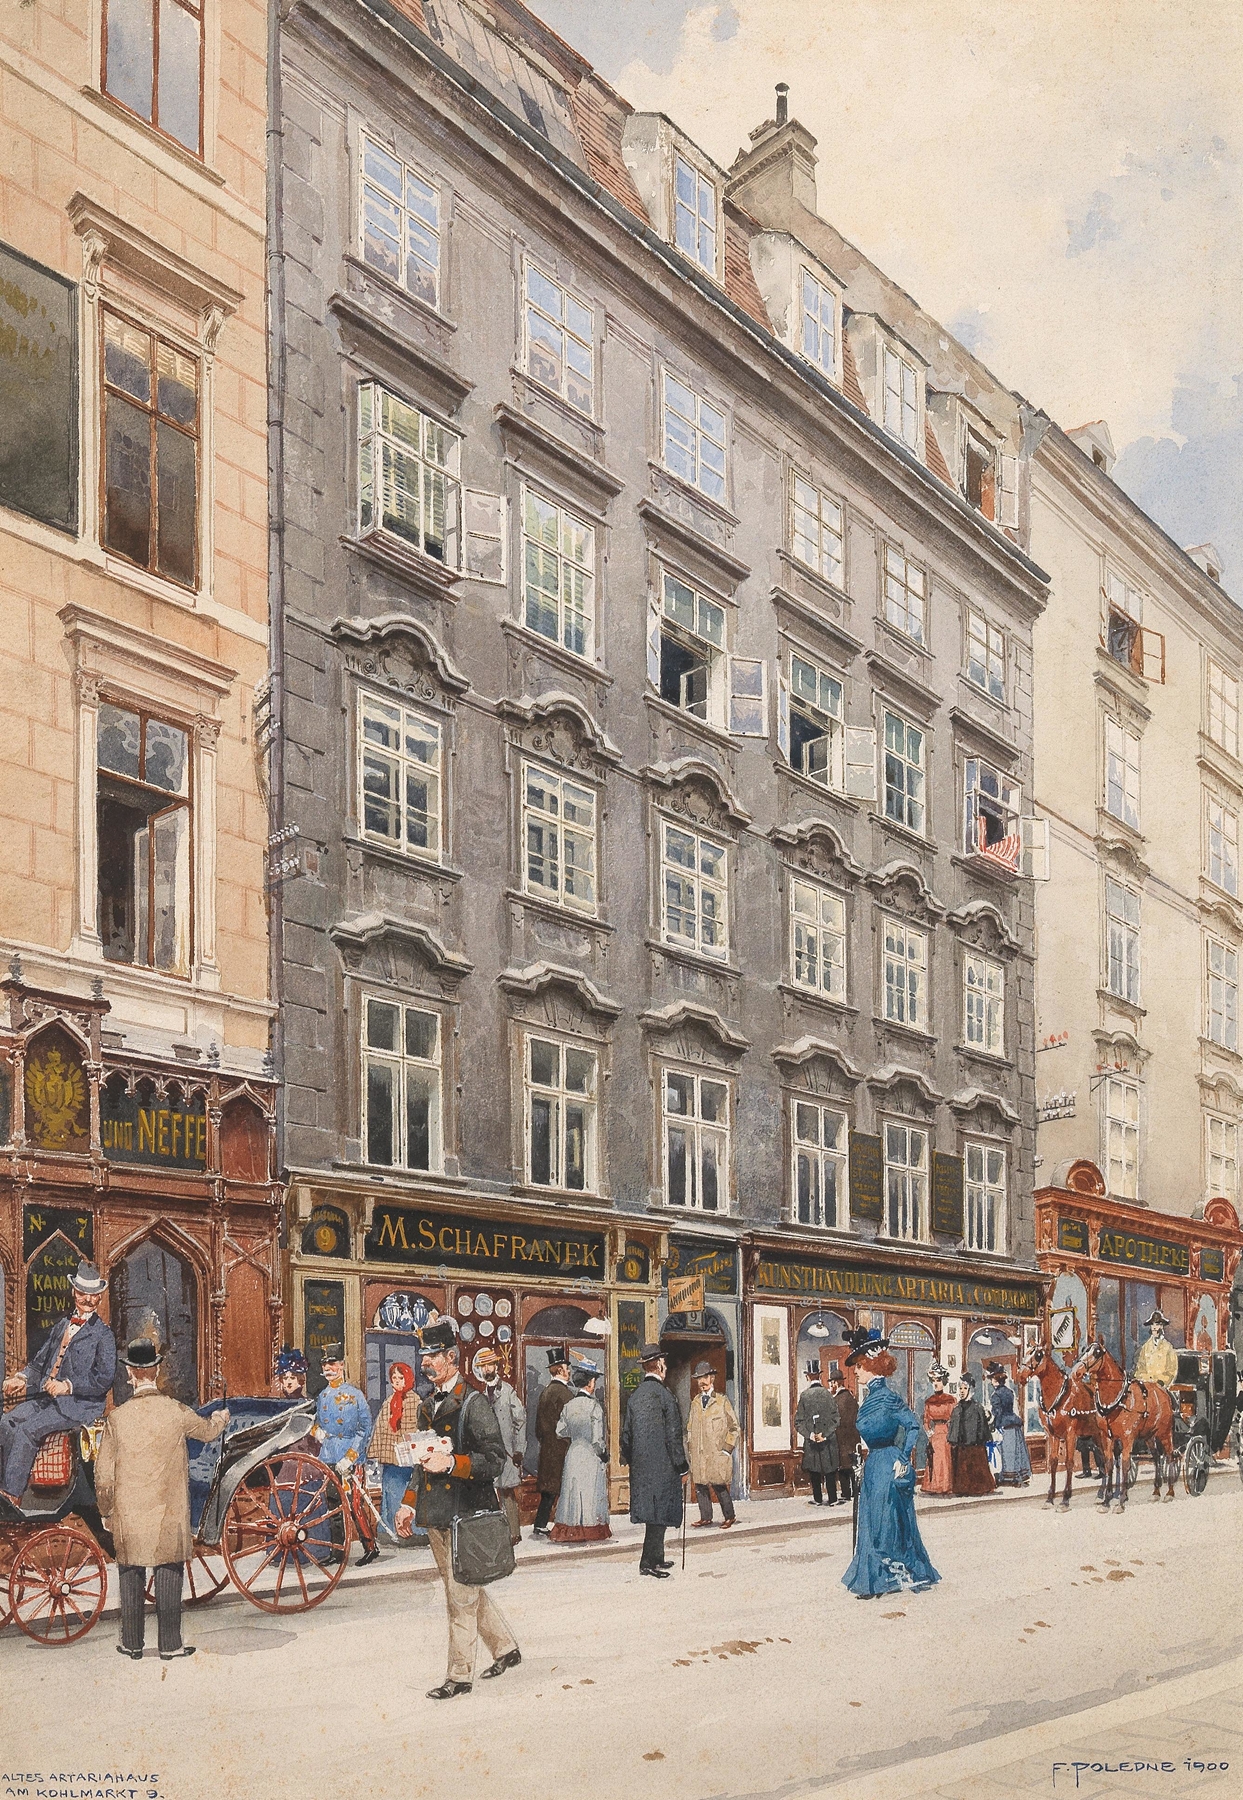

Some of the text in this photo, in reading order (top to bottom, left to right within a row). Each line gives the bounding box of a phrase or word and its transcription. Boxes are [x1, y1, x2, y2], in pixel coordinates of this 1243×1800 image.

[138, 1108, 206, 1160] NEFFE
[75, 1217, 88, 1239] 7
[320, 1228, 332, 1247] 9
[1100, 1233, 1189, 1268] APOTHEKE
[894, 1276, 964, 1304] ARTARIA
[690, 1310, 698, 1322] 9
[1, 1772, 160, 1784] ALTES ARTARIAHAUS
[5, 1787, 29, 1797] AM
[36, 1788, 138, 1799] KOHLMARKT
